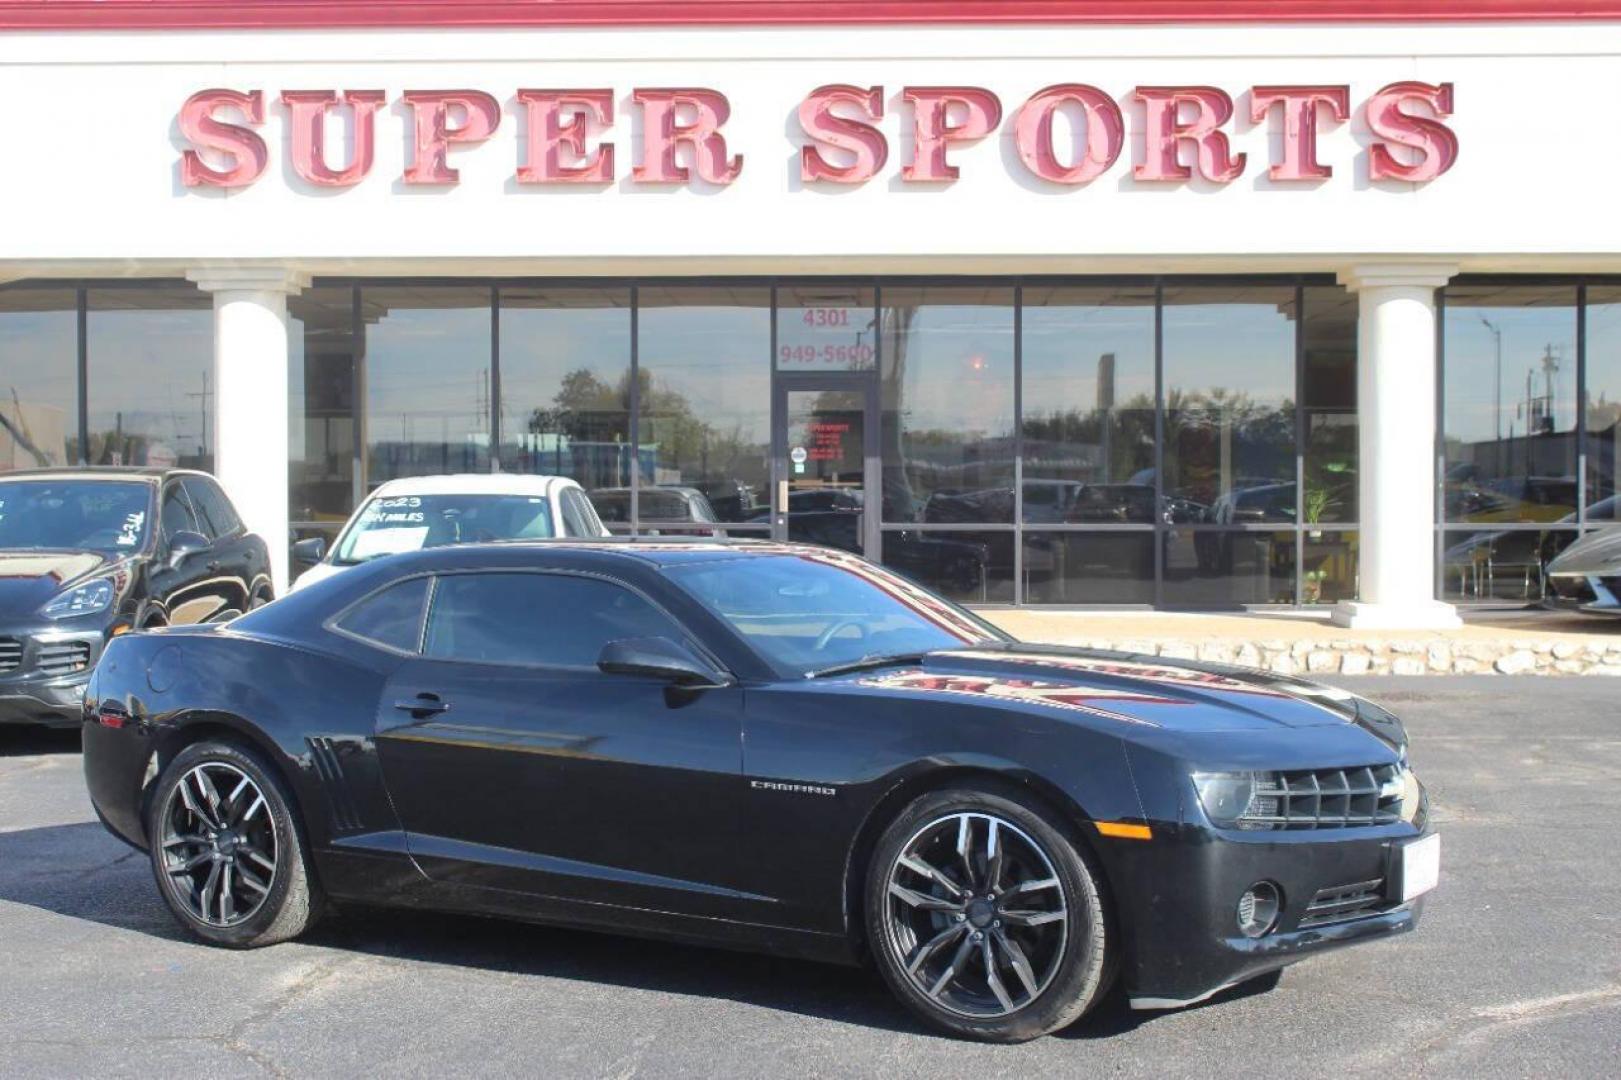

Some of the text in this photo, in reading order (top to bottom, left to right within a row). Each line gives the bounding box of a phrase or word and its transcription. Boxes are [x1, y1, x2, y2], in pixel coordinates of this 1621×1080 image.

[178, 80, 1459, 189] SUPER SPORTS
[802, 308, 848, 327] 4301
[375, 496, 422, 508] 2023
[751, 780, 836, 795] CAMARO
